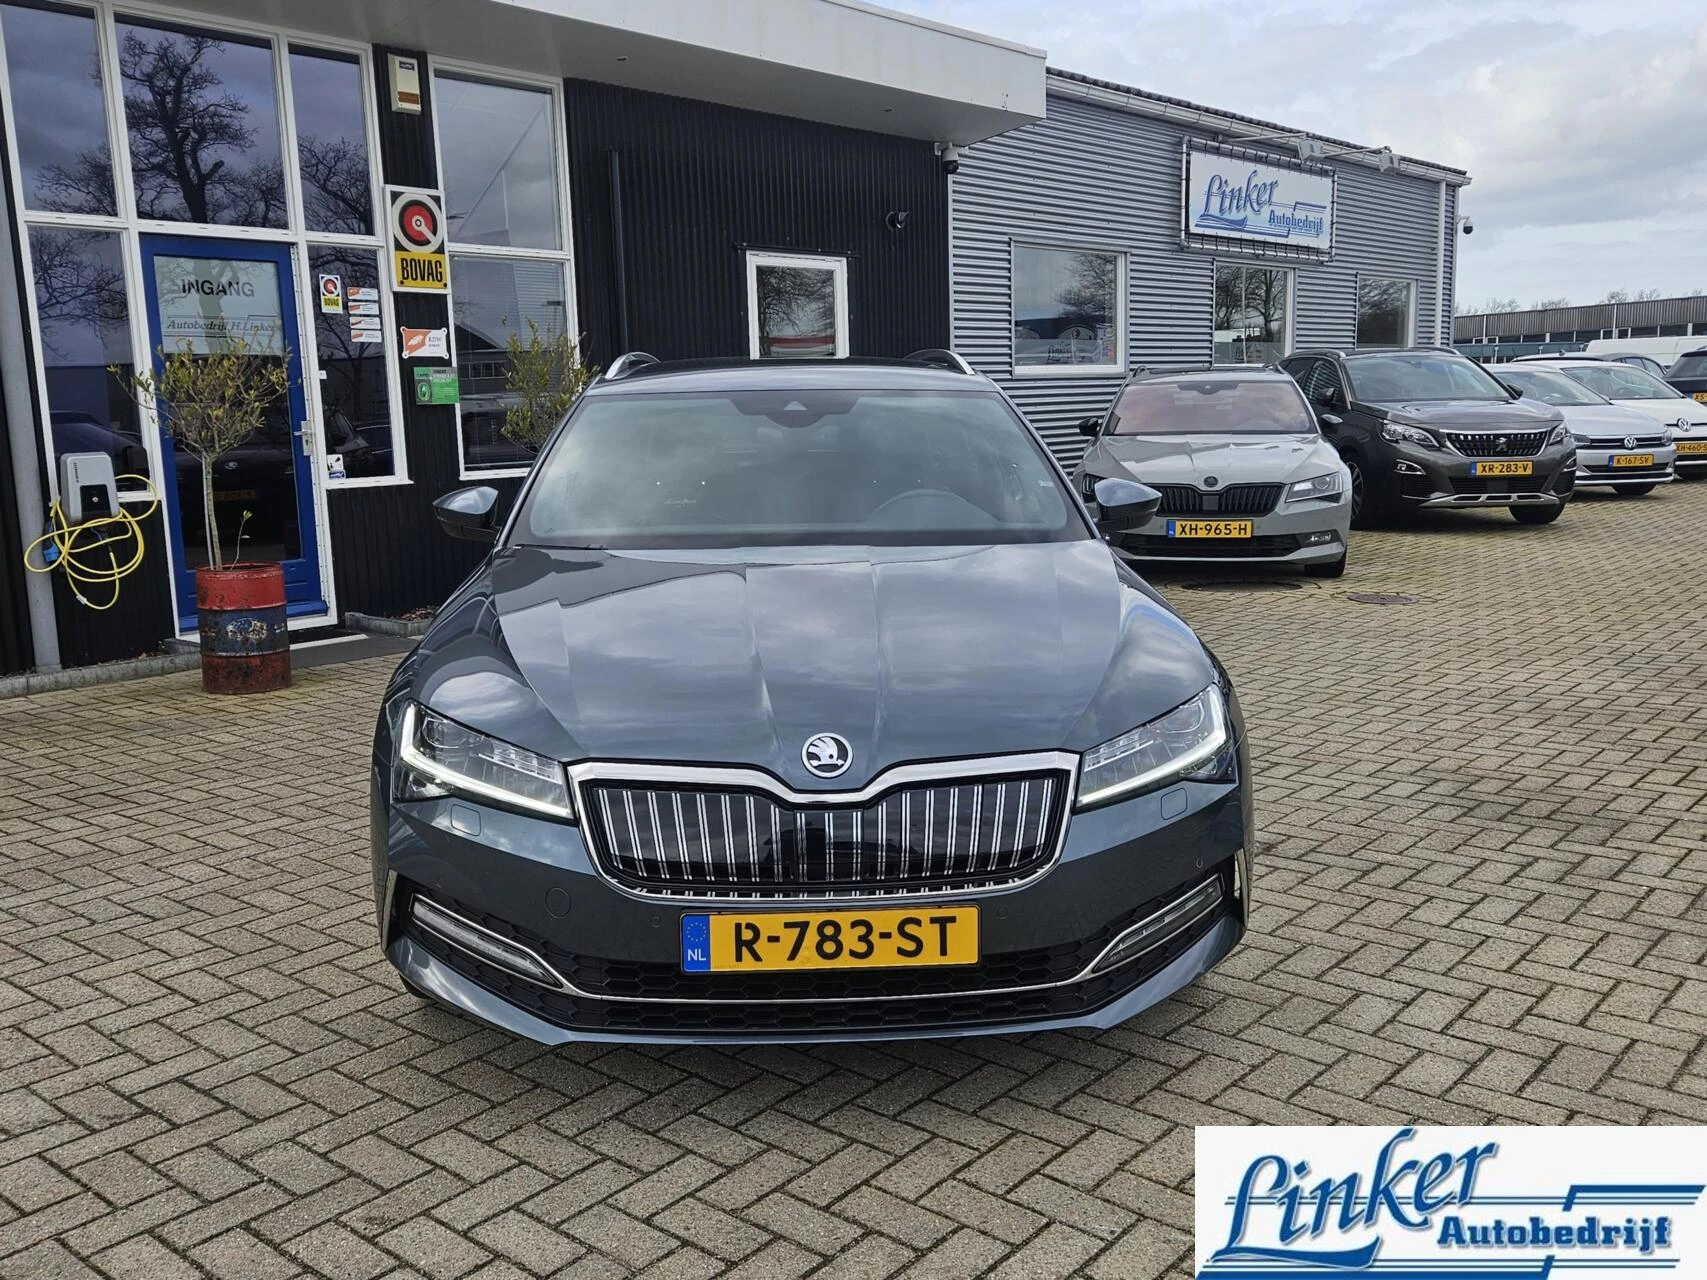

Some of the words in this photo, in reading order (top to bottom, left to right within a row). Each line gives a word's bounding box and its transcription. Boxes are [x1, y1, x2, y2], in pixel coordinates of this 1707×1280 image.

[1198, 170, 1279, 227] Linker
[1269, 210, 1323, 234] Autobedrijf
[400, 257, 443, 283] BOVAG
[182, 279, 255, 297] INGANG
[323, 298, 340, 307] BOVAG
[1481, 463, 1529, 473] XR-283-V
[1616, 457, 1649, 465] K-167-SV
[1179, 523, 1247, 536] XH-965-H
[687, 948, 707, 961] NL
[734, 915, 957, 963] R-783-ST
